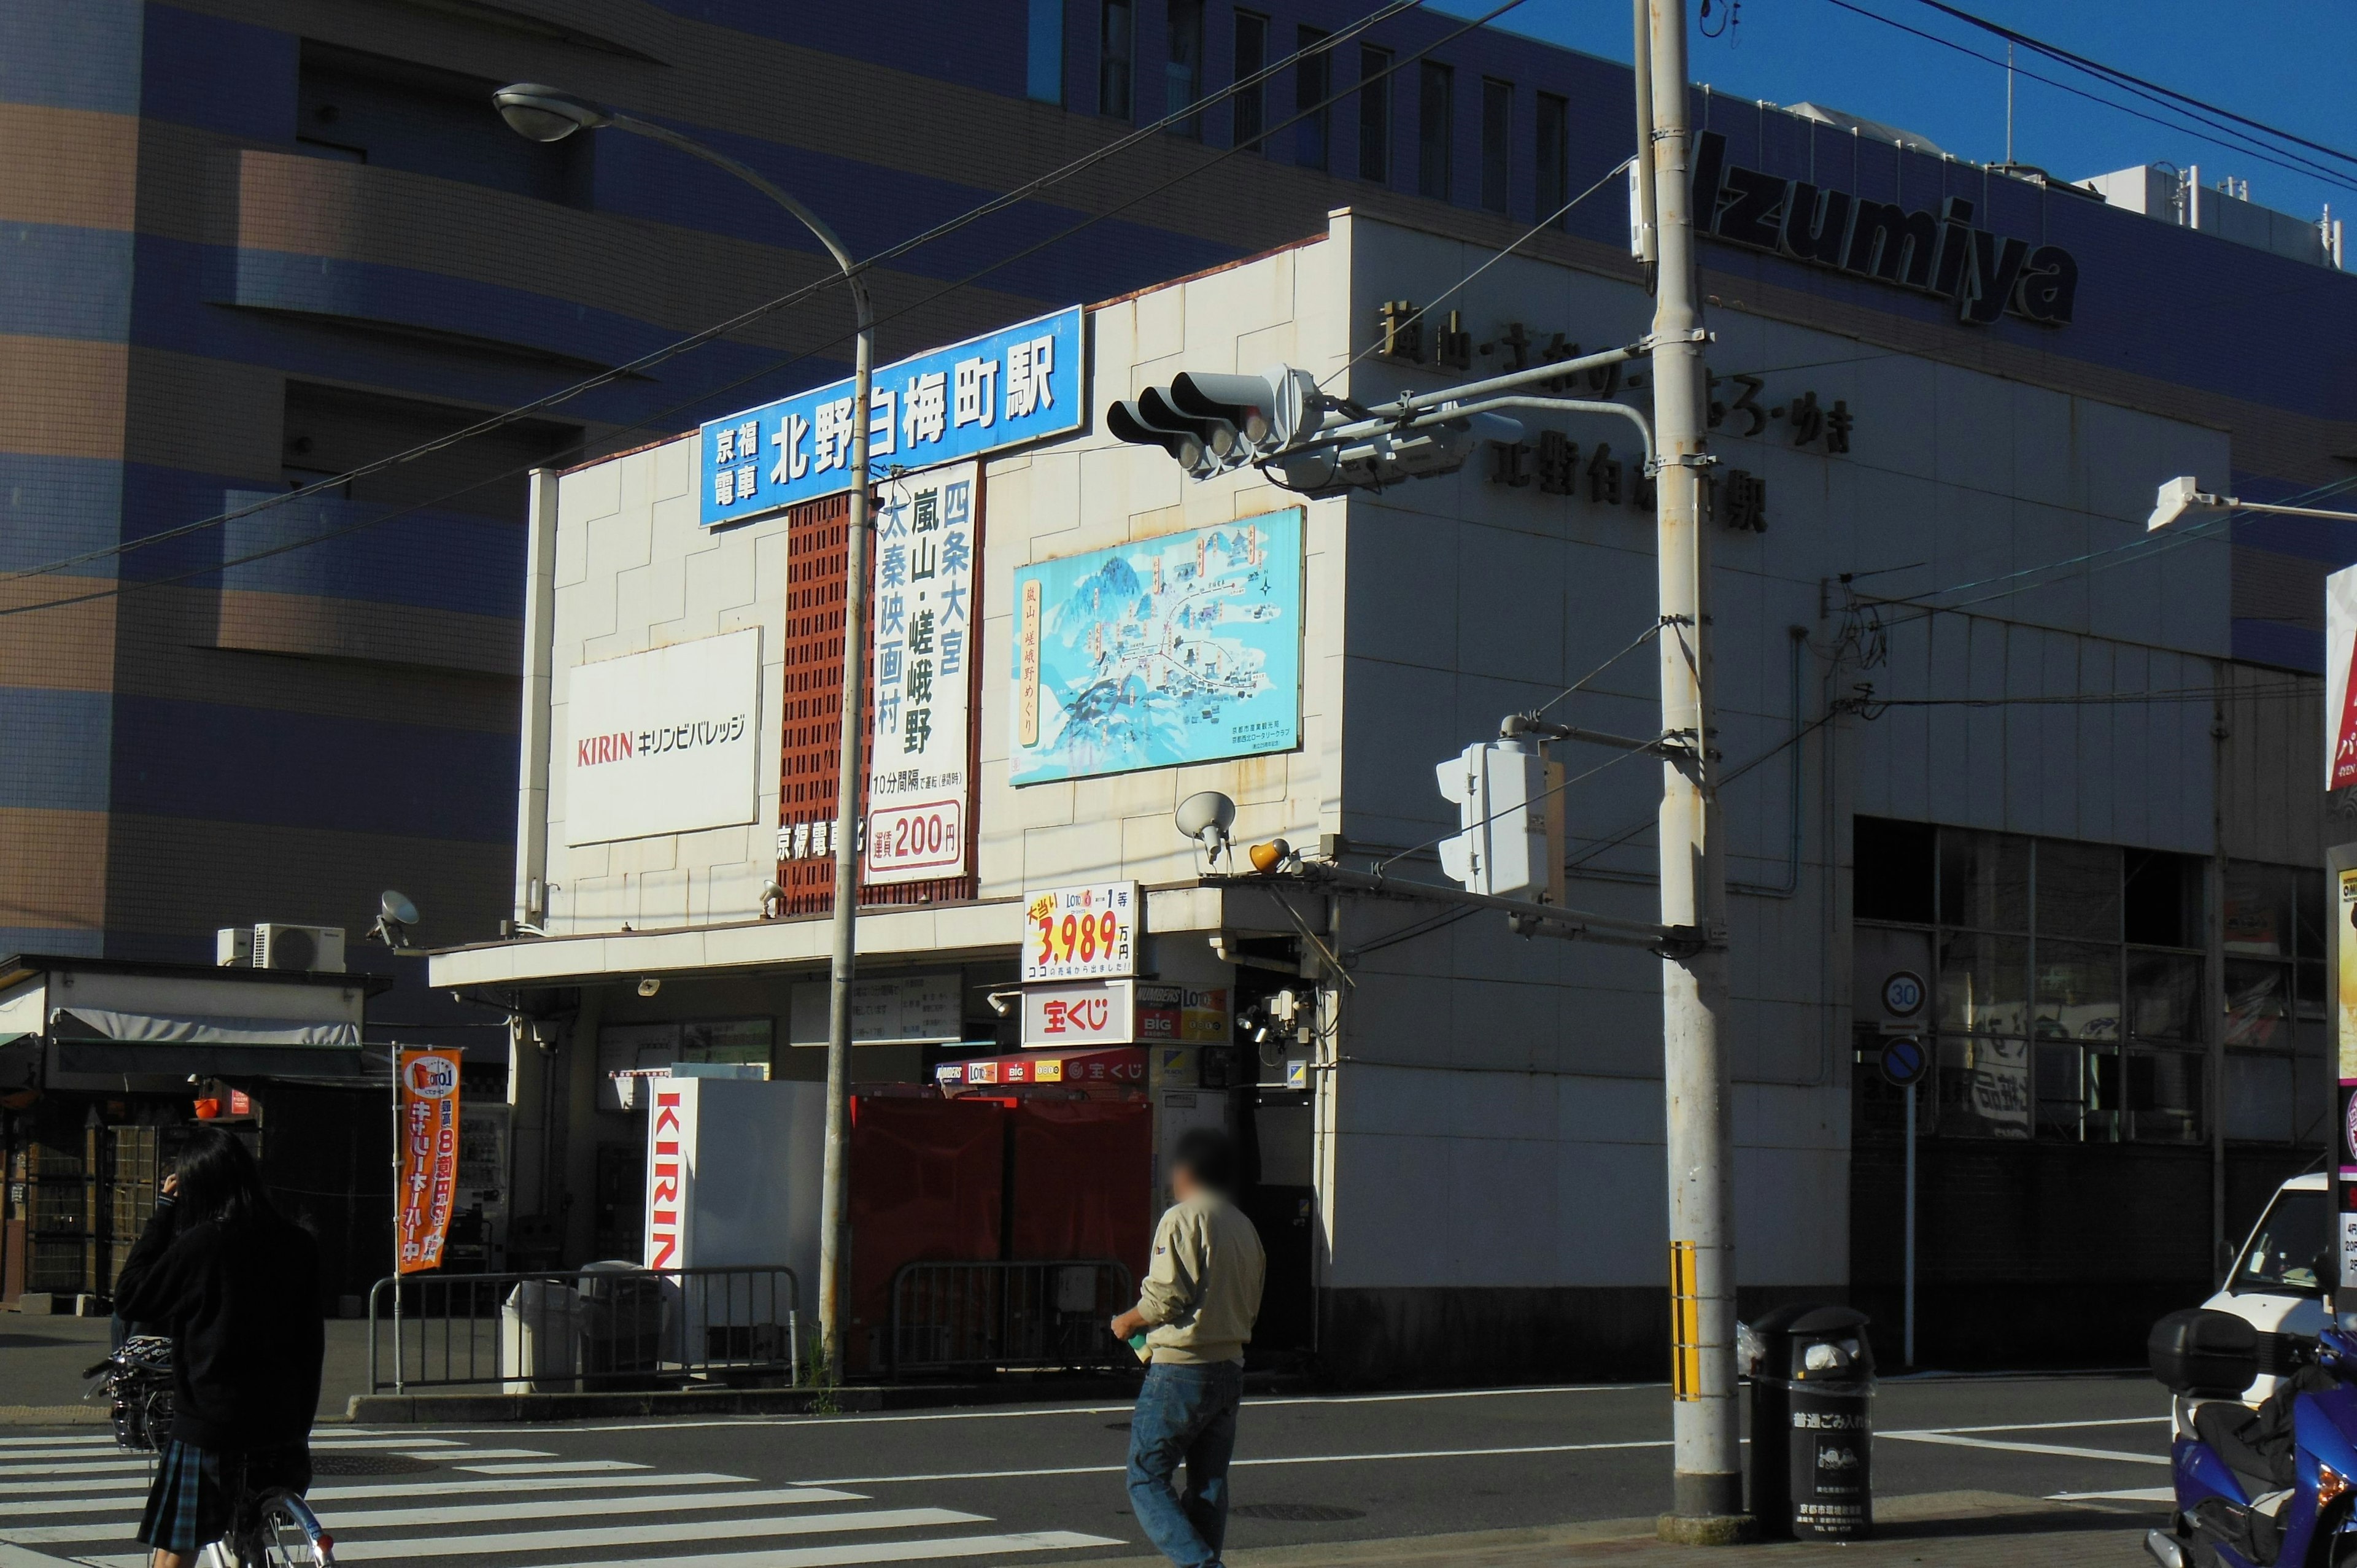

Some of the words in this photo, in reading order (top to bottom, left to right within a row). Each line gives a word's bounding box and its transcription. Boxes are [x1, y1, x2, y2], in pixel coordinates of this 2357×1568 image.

[1690, 129, 2080, 326] Izumiya
[770, 334, 1055, 485] 北野白梅町駅
[715, 420, 759, 465] 京福
[714, 465, 759, 506] 電車
[1488, 430, 1768, 533] 北野白駅
[940, 477, 971, 678] 四条大宮
[878, 495, 908, 736] 太秦映画村
[903, 487, 939, 755] 嵐山・嵯峨野
[577, 731, 633, 767] KIRIN
[638, 714, 745, 757] キリンビバレッジ
[873, 831, 892, 859] 運賃
[894, 813, 955, 857] 200円
[1039, 911, 1116, 965] 3,989
[1044, 998, 1108, 1033] 宝くじ
[1137, 987, 1180, 1003] NUMBERS
[1891, 984, 1918, 1005] 30
[1089, 1064, 1142, 1079] 宝くじ
[651, 1093, 681, 1279] KIRIN
